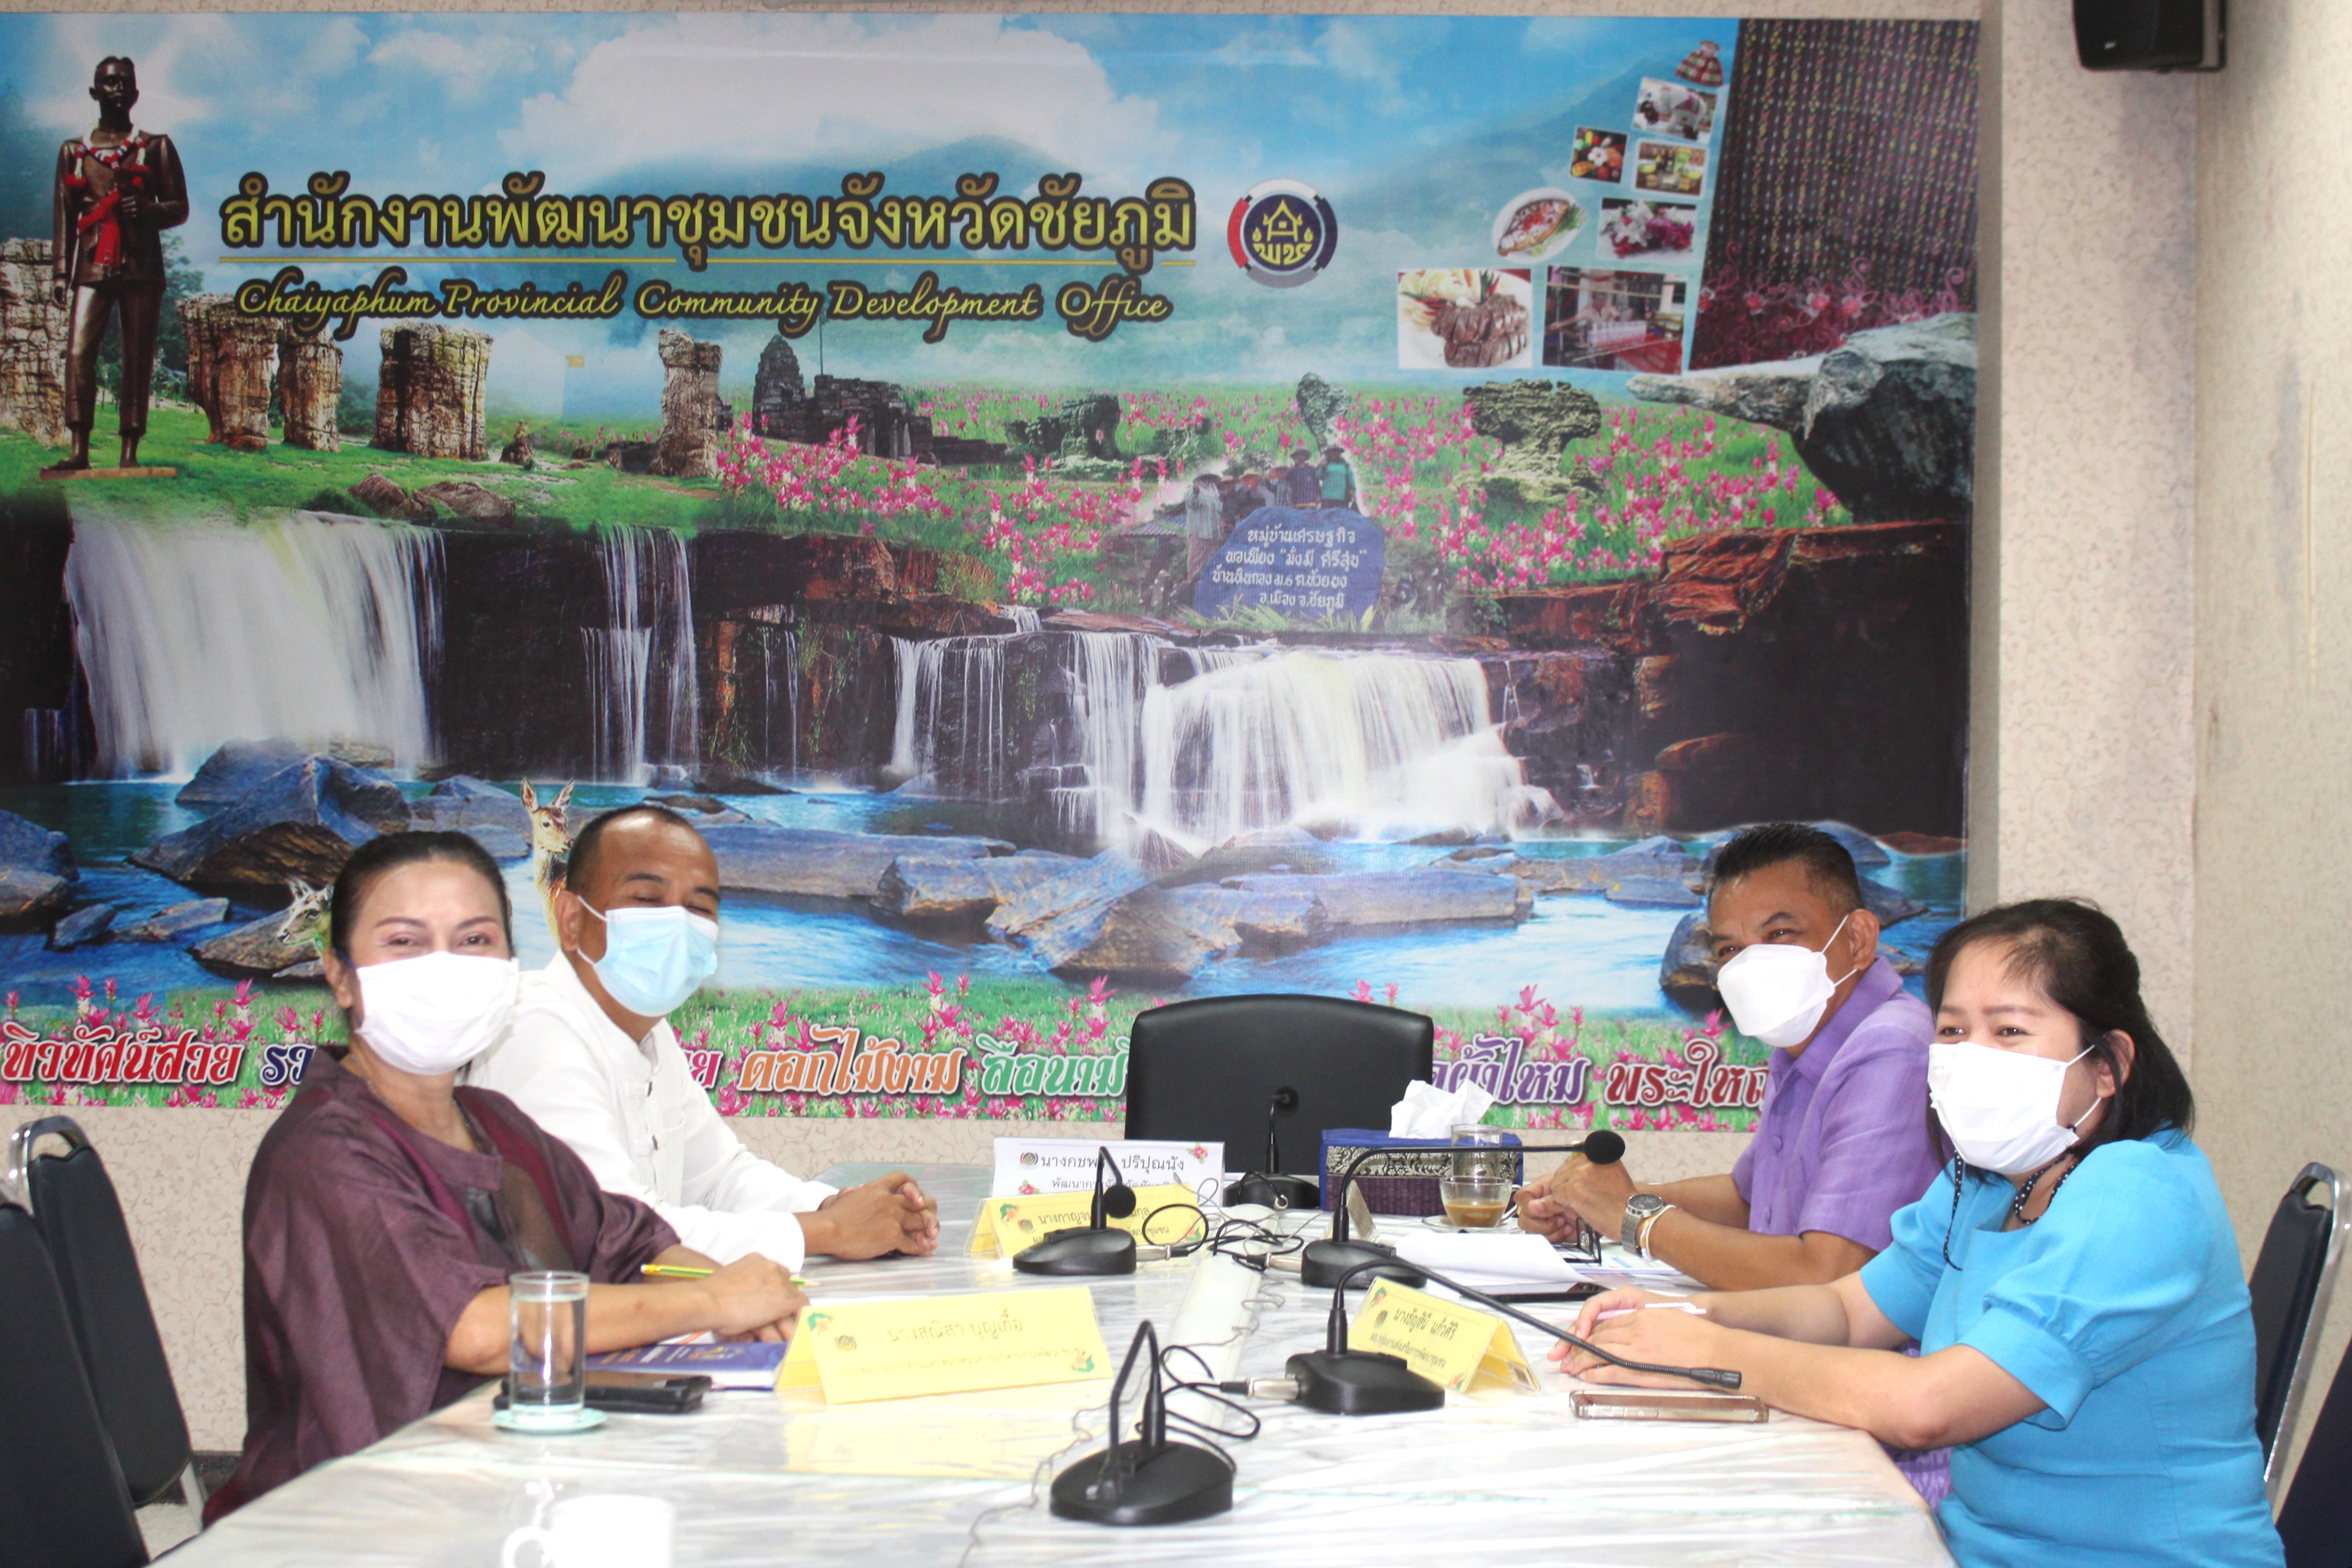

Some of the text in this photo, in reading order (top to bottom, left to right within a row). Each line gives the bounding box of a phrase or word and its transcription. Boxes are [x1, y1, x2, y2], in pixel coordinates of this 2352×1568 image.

[219, 171, 1196, 272] สำนักงานพัฒนาชุมชนจังหวัดชัยภูมิ
[235, 265, 1175, 344] Chaiyaphum Provincial Community Development Office
[1, 1022, 245, 1085] ทิวทัศน์สวย
[737, 1024, 966, 1097] ดอกไม้งาม
